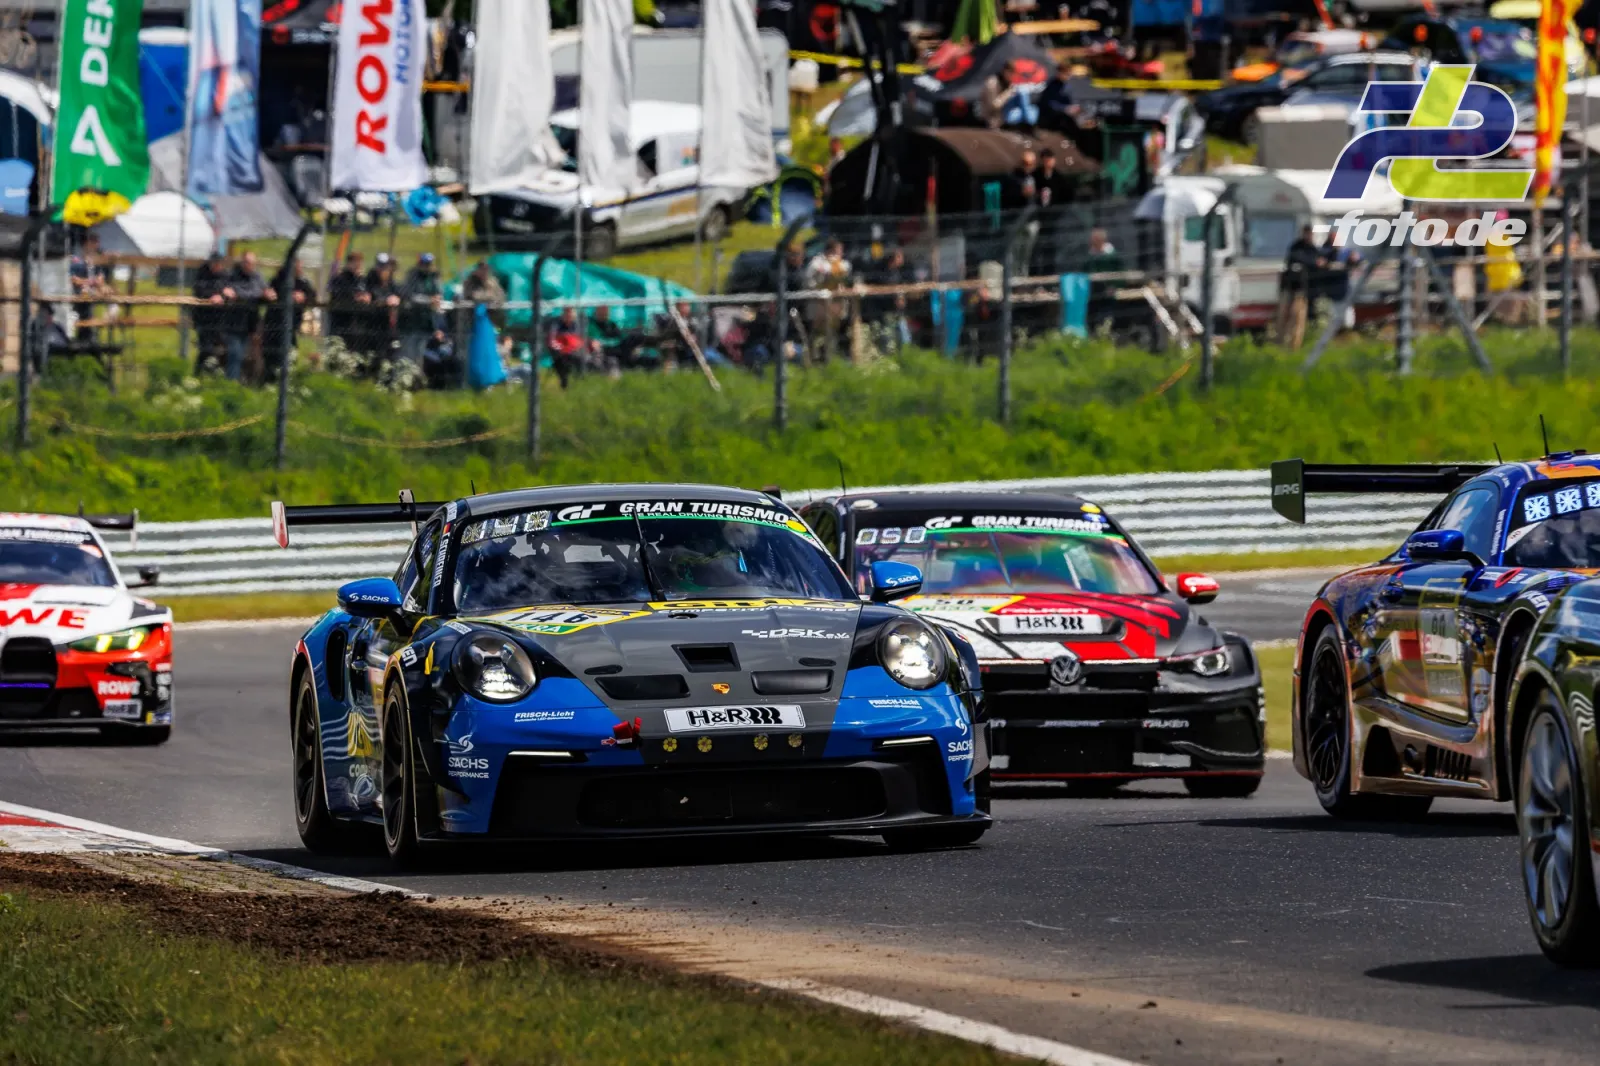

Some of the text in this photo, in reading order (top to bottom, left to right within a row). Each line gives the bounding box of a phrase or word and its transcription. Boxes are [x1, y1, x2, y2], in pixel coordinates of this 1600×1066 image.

[620, 502, 683, 514] GRAN
[690, 502, 789, 524] TURISMO
[971, 515, 1022, 527] GRAN
[1023, 516, 1104, 533] TURISMO
[361, 594, 390, 603] SACHS
[507, 611, 598, 623] 146
[1015, 616, 1058, 629] H&R
[769, 628, 826, 638] DSK
[514, 710, 575, 719] FRISCH-Licht
[687, 708, 747, 726] H&R
[448, 757, 489, 769] SACHS
[448, 770, 490, 779] PERFORMANCE
